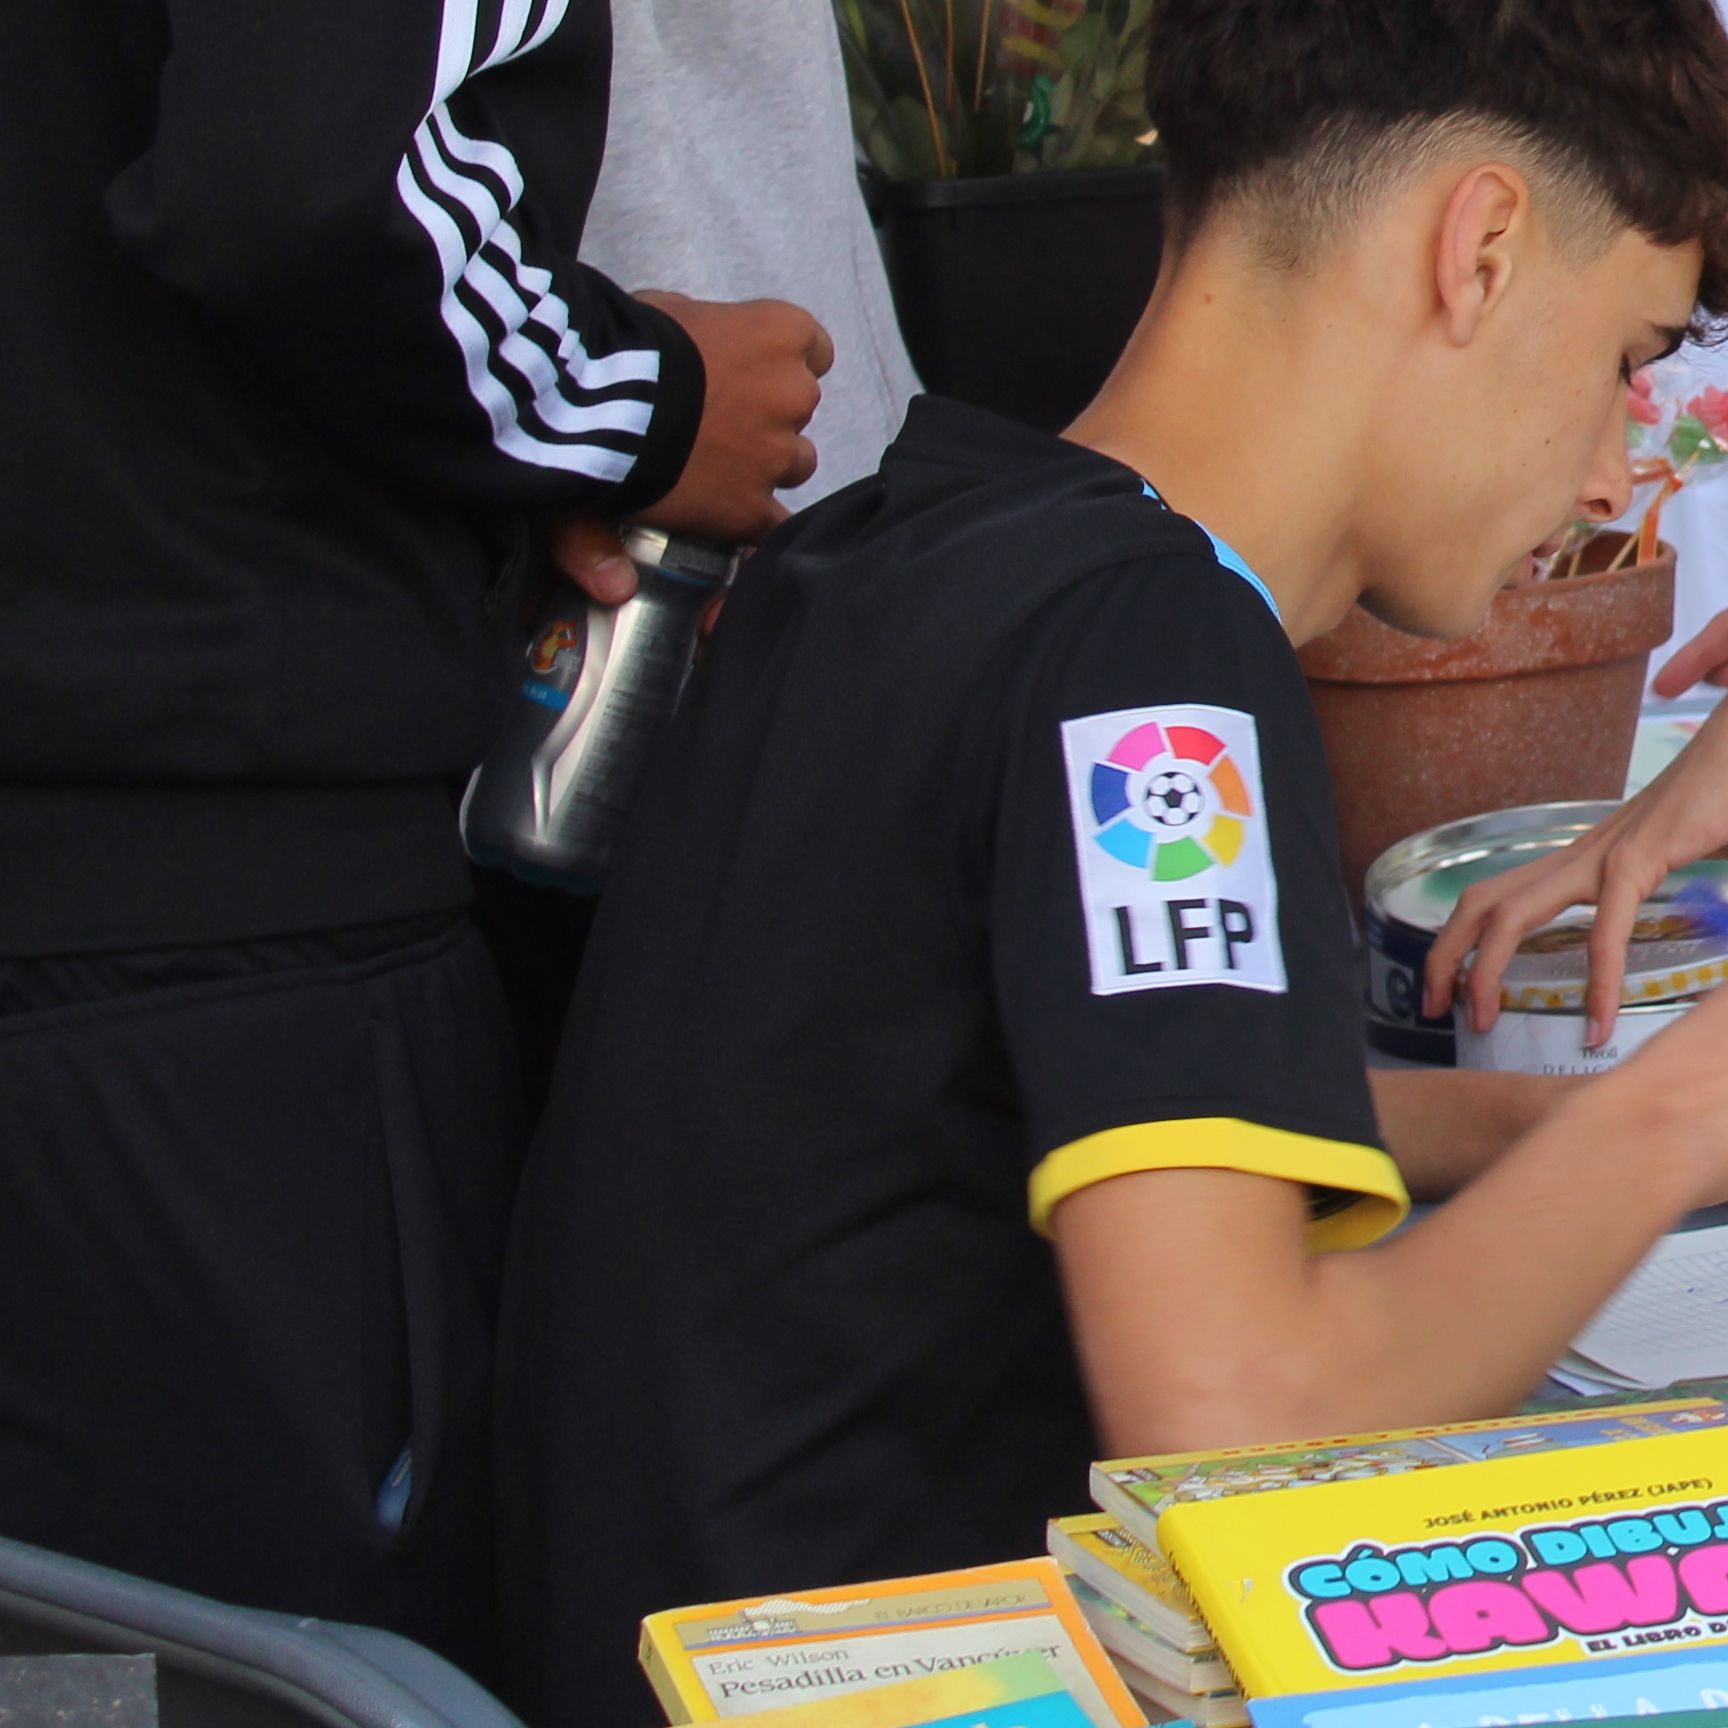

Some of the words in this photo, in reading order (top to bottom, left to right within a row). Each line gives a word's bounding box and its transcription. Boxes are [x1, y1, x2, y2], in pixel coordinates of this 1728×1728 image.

[1112, 897, 1255, 976] LFP
[1424, 1506, 1476, 1529] JOSÉ
[1480, 1496, 1573, 1522] ANTONIO
[1578, 1482, 1641, 1510] PÉREZ
[1646, 1476, 1714, 1503] (JAPE)
[1298, 1534, 1520, 1600] CÓMO
[1587, 1635, 1616, 1654] EL
[1621, 1622, 1701, 1651] LIBRO
[709, 1657, 754, 1676] Eric
[764, 1647, 850, 1669] Wilson
[719, 1666, 867, 1699] Pesadilla
[874, 1660, 910, 1678] en
